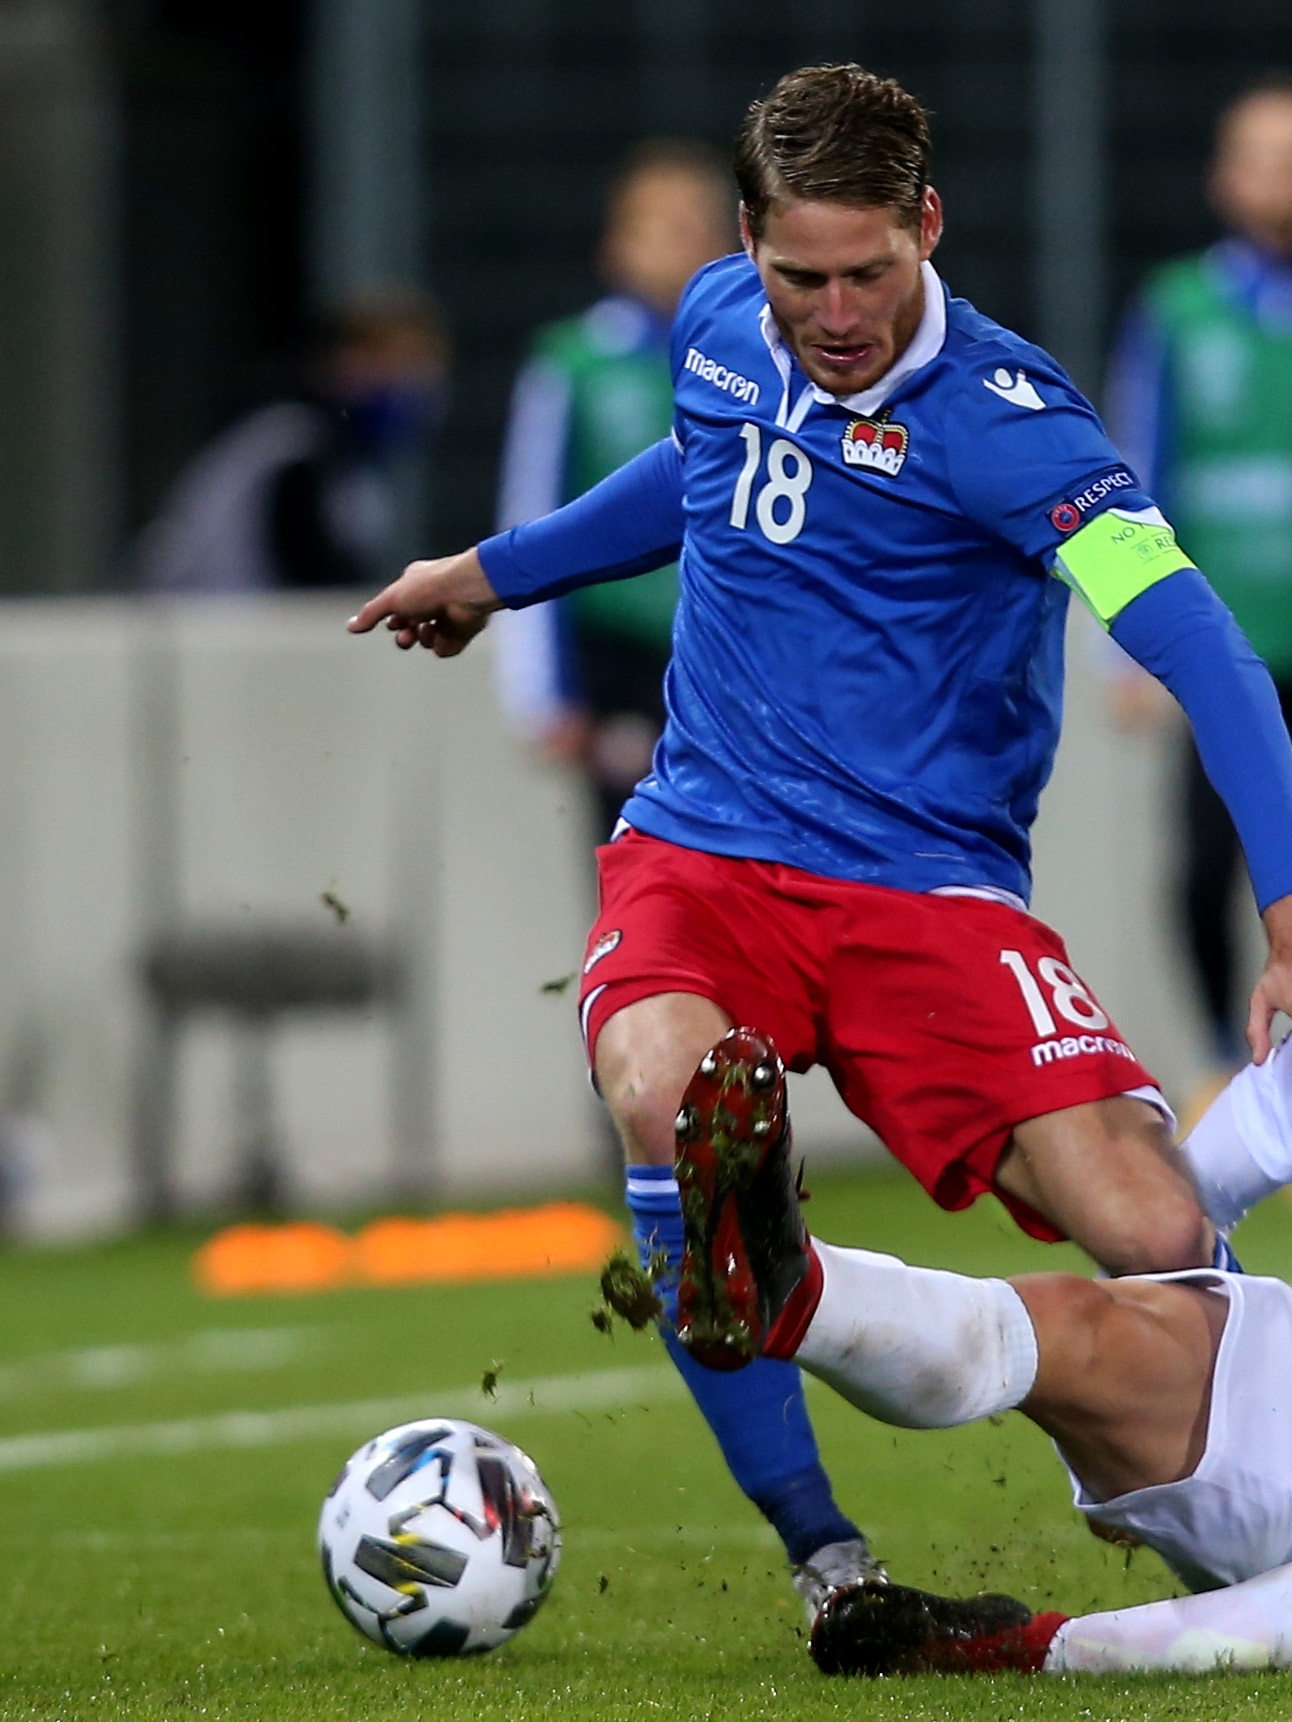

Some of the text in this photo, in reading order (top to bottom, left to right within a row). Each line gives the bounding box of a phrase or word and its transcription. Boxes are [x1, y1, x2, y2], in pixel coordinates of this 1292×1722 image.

[684, 348, 760, 405] macron
[729, 422, 813, 544] 18
[1073, 471, 1134, 512] RESPECT
[1110, 526, 1135, 545] NO
[1000, 949, 1109, 1038] 18
